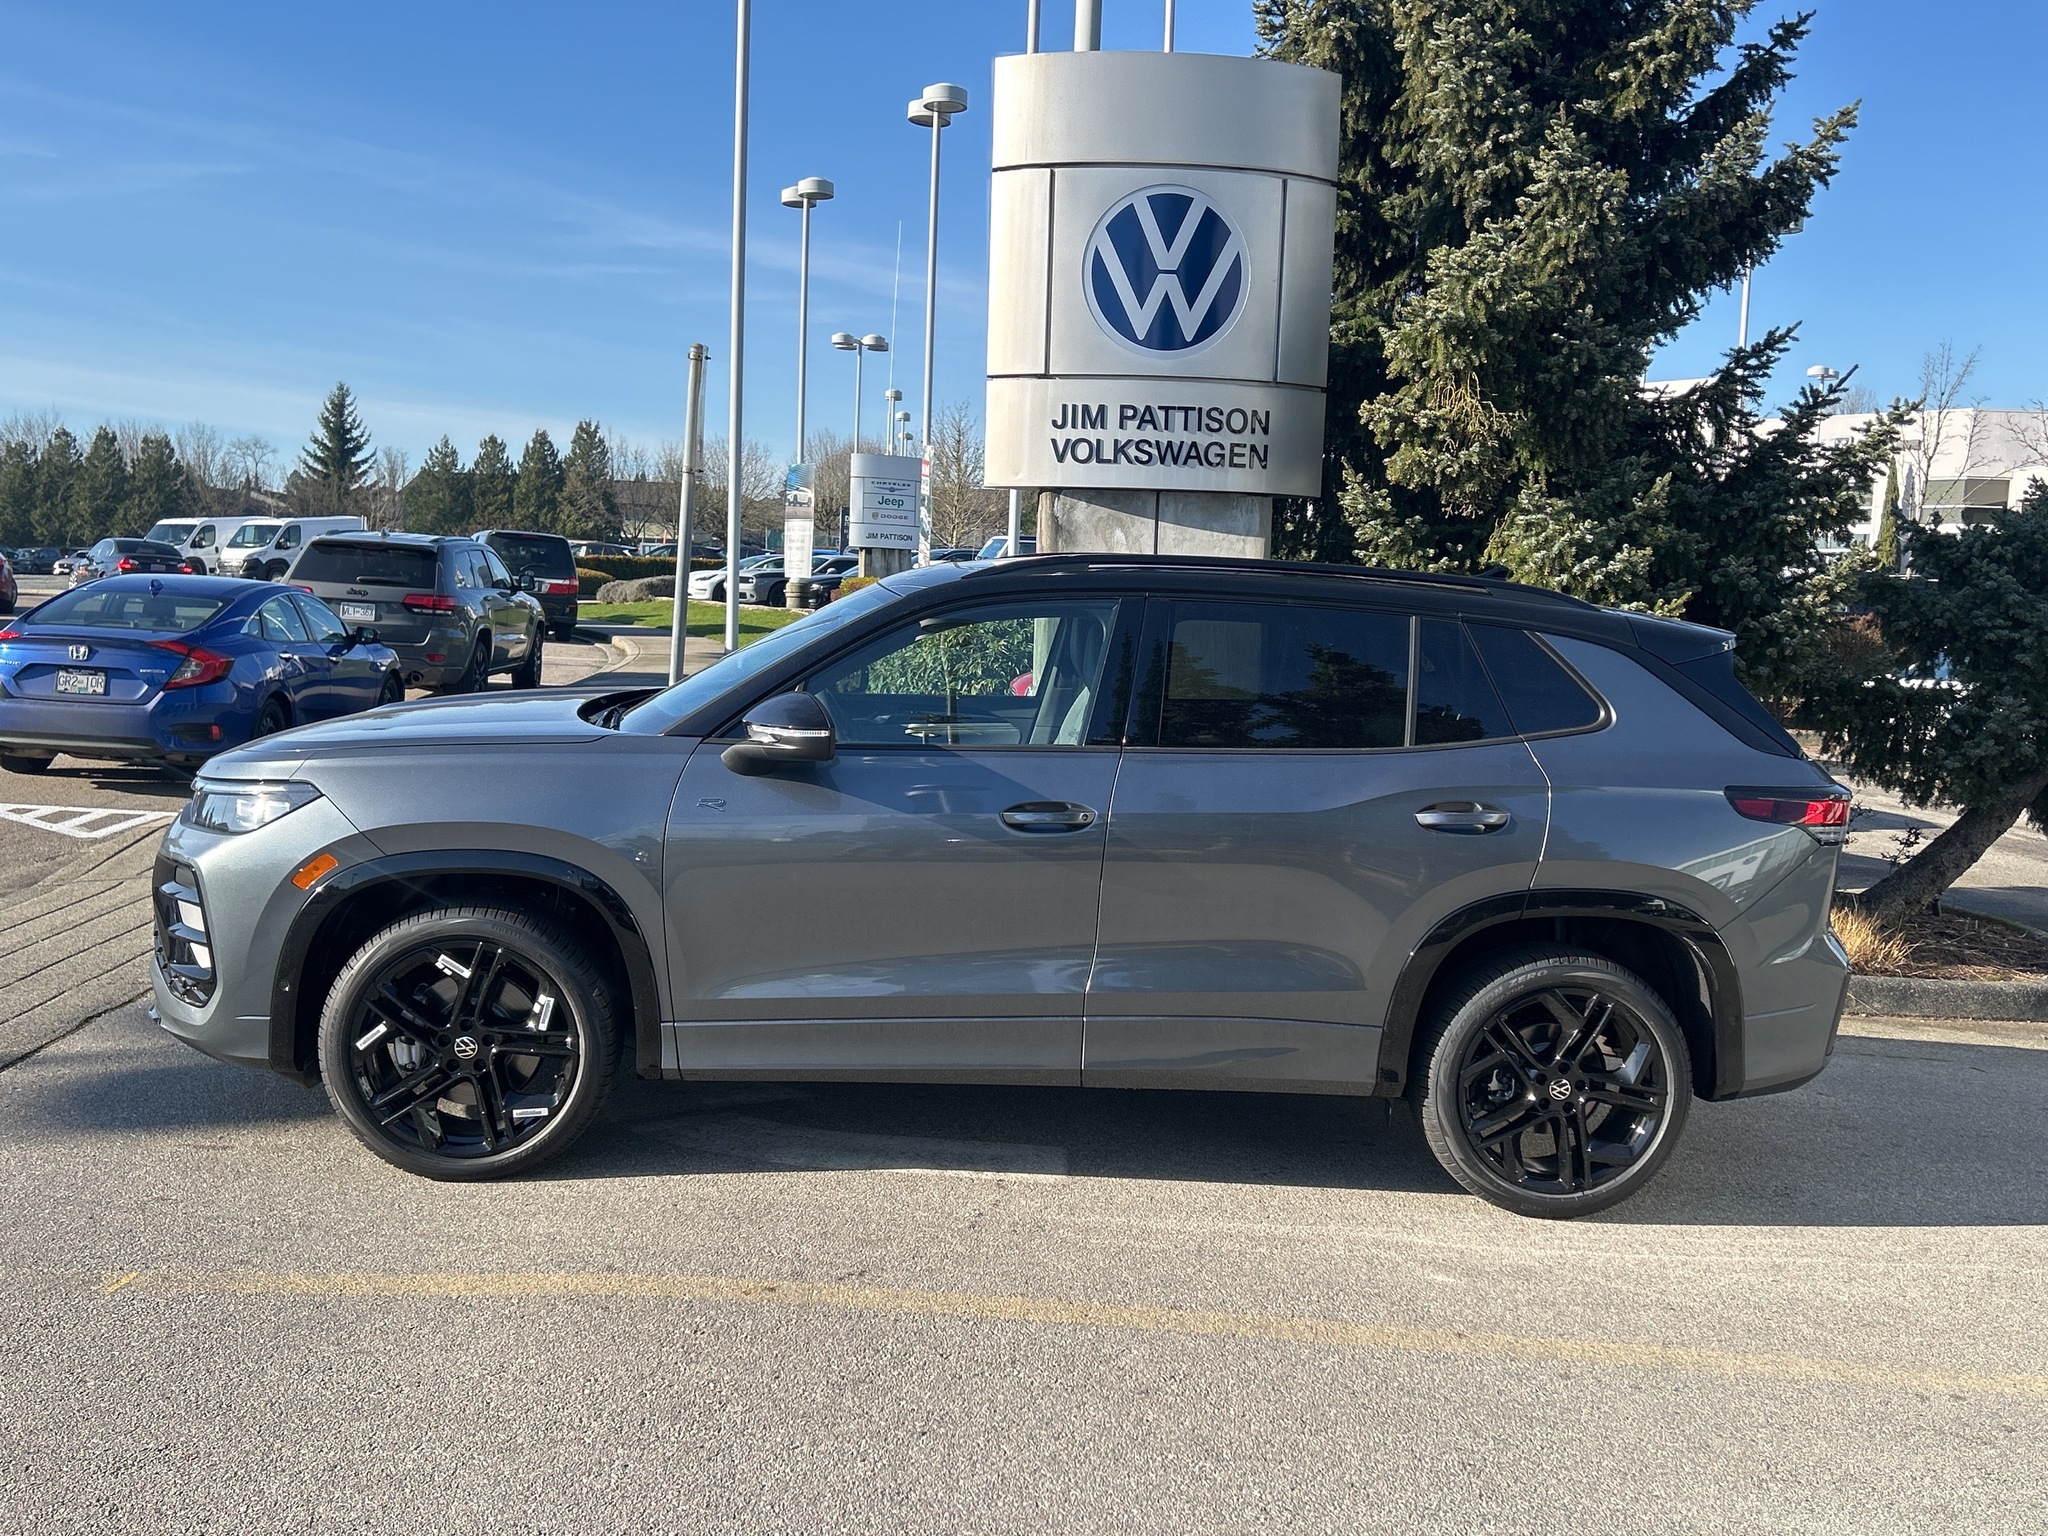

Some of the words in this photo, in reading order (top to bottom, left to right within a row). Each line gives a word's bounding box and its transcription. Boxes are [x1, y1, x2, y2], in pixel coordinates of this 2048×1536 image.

[1051, 402, 1106, 430] JIM
[1118, 404, 1271, 436] PATTISON
[1050, 437, 1269, 469] VOLKSWAGEN
[878, 496, 904, 508] Jeep
[880, 533, 913, 541] PATTISON
[1508, 970, 1548, 988] ZERO
